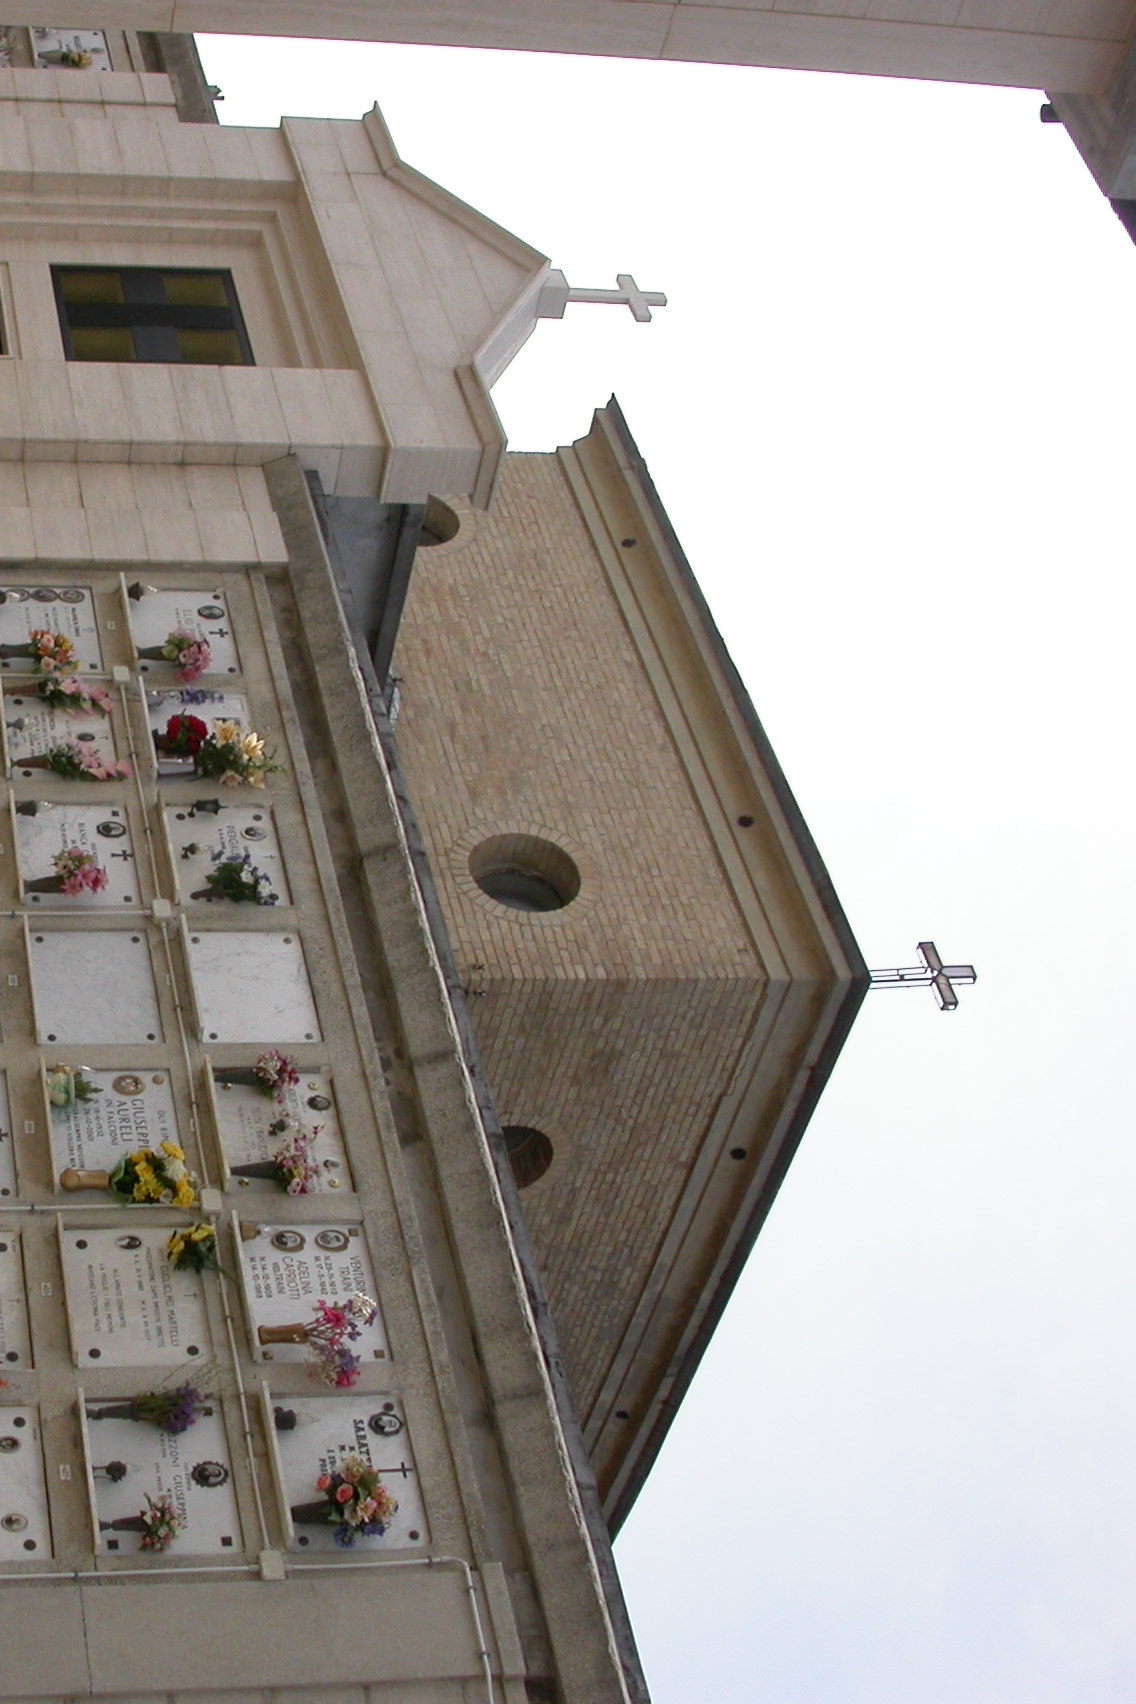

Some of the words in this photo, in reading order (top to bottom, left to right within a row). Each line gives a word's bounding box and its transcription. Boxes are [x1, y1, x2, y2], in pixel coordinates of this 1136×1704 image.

[116, 1100, 134, 1142] AURELI
[131, 1098, 150, 1149] GIUSEPPI
[282, 1256, 300, 1300] CAPRIOTTI
[296, 1260, 313, 1296] ADELINA
[338, 1266, 354, 1292] TRAINI
[350, 1256, 367, 1297] VENTURIN
[166, 1310, 180, 1348] MARTELLI
